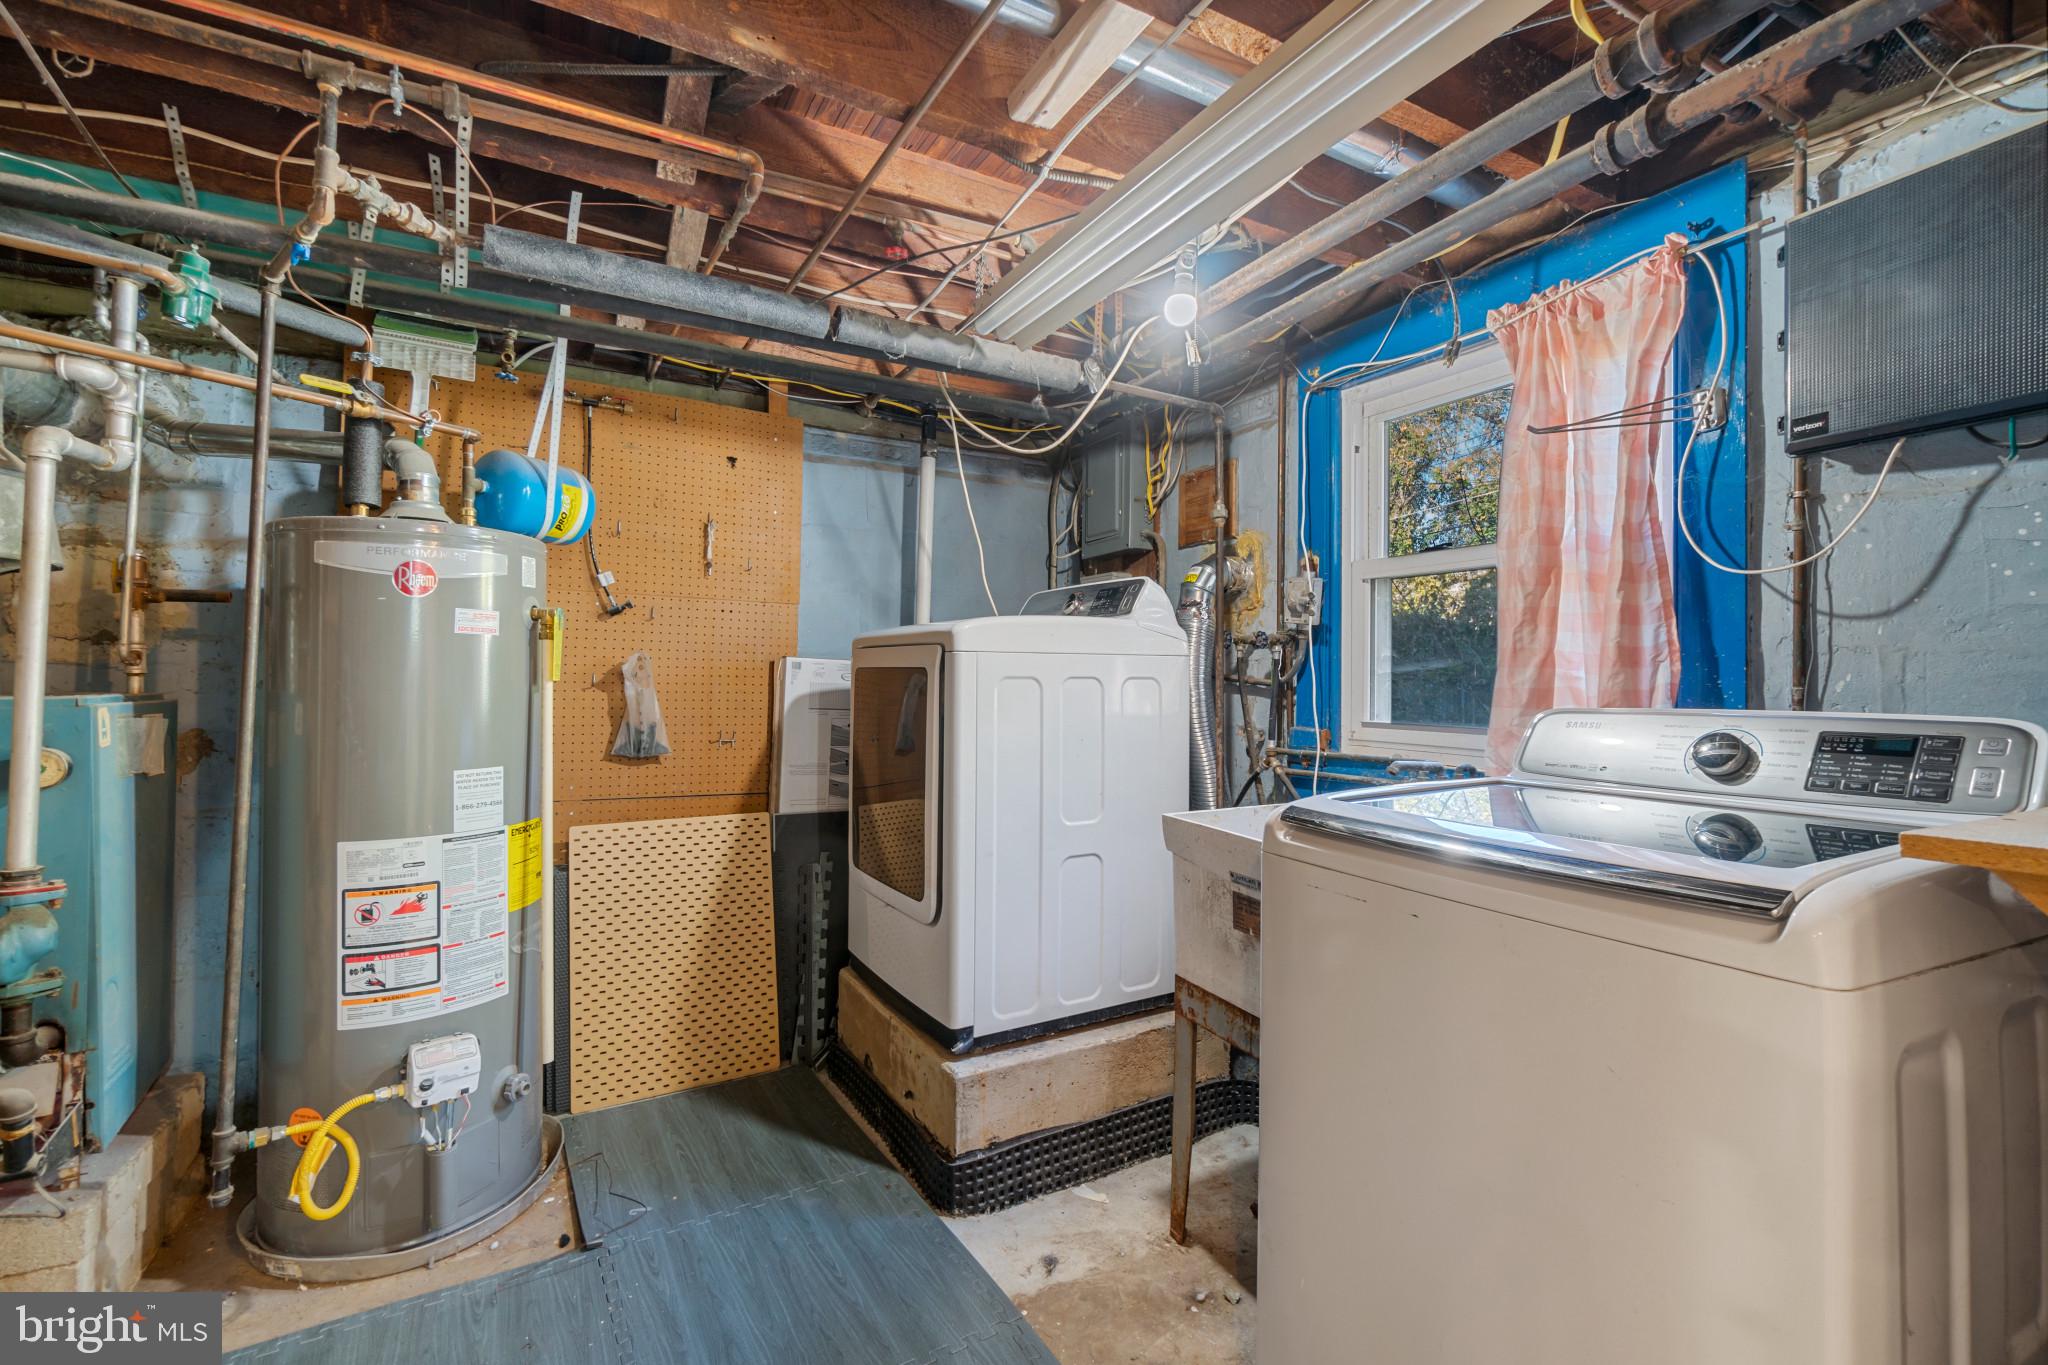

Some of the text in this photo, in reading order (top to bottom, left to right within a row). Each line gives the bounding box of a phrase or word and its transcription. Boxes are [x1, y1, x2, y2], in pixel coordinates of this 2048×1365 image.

[1793, 421, 1824, 432] verizon
[398, 560, 436, 591] Rheem
[1566, 721, 1607, 729] SAMSU
[379, 888, 412, 896] WARNING
[380, 951, 410, 960] DANGER
[381, 993, 411, 1002] WARNING
